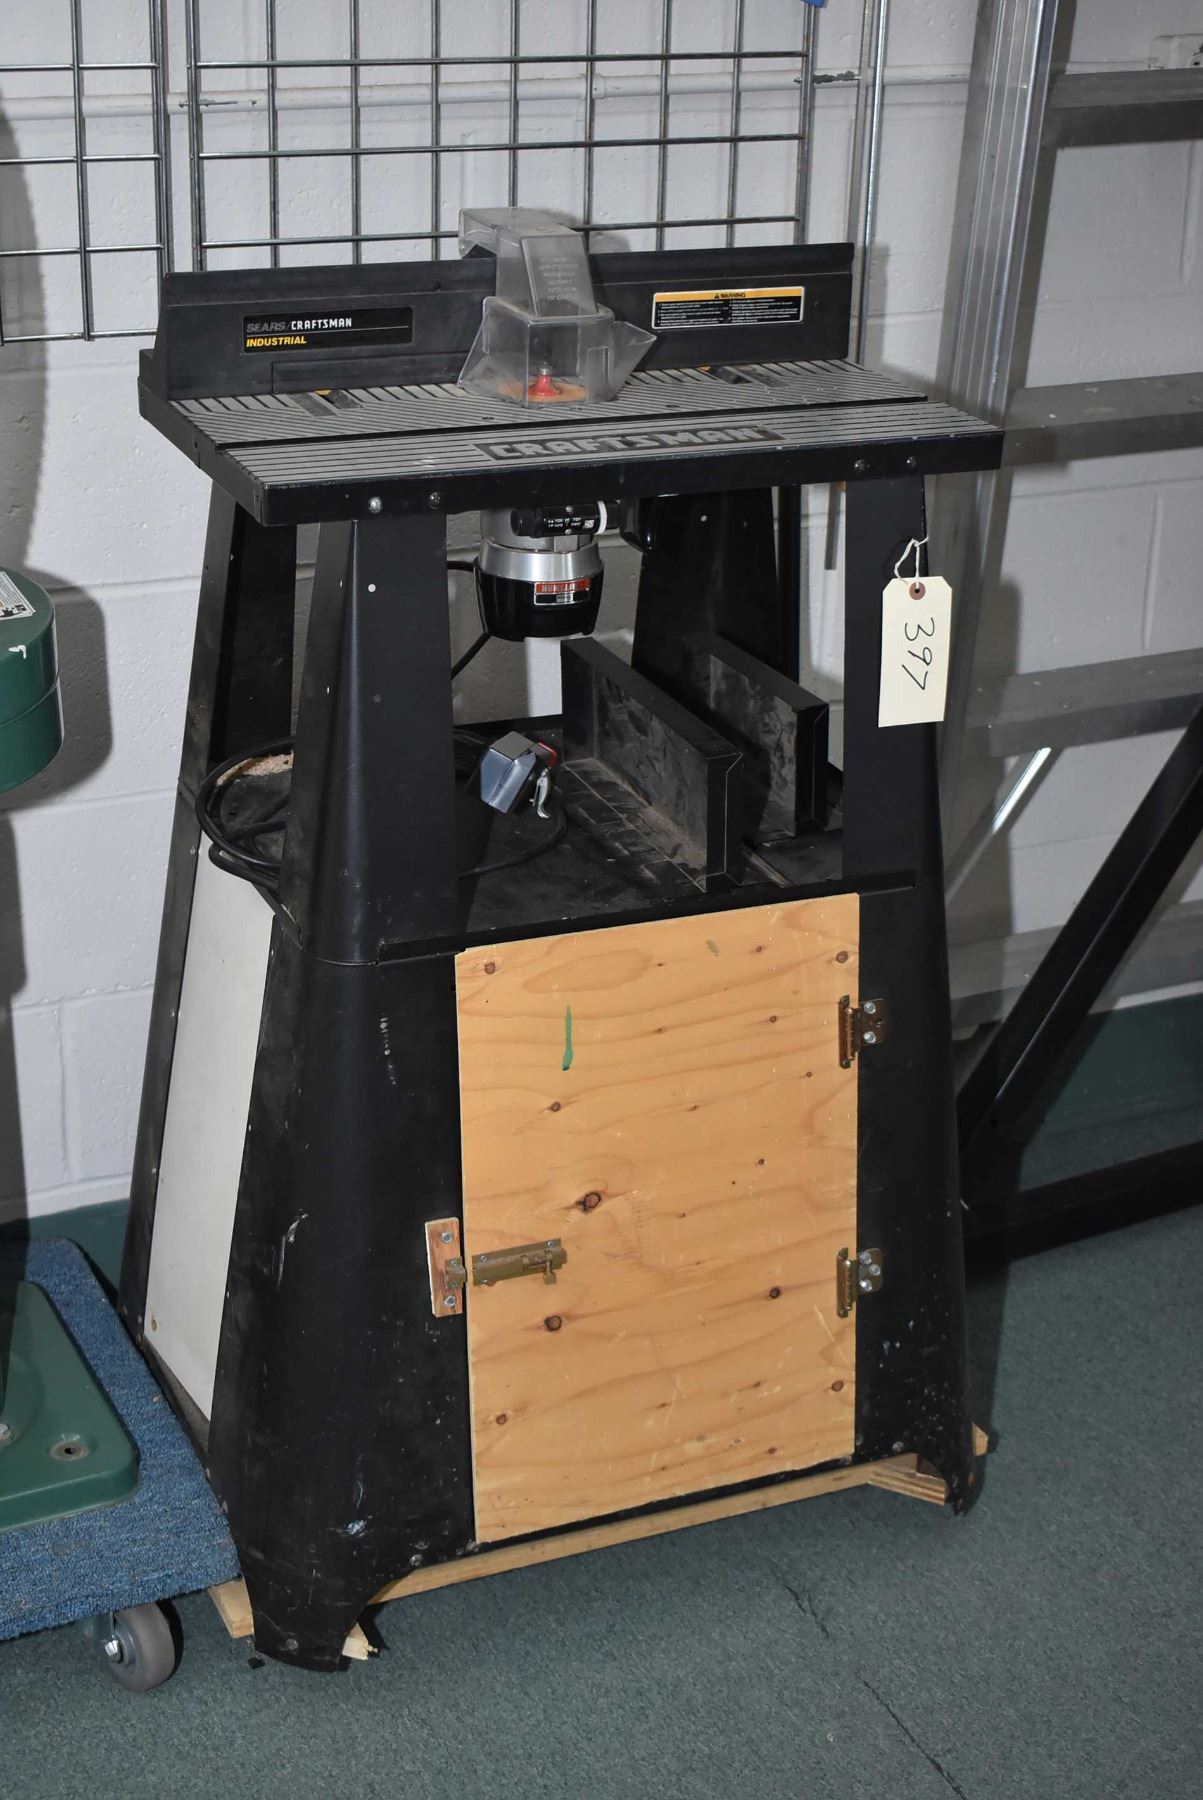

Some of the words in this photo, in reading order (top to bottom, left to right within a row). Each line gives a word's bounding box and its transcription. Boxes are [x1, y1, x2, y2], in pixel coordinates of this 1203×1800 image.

[291, 317, 352, 331] CRAFTSMAN
[246, 335, 307, 347] INDUSTRIAL
[488, 427, 760, 458] CRAFTSMAN
[902, 617, 935, 690] 397
